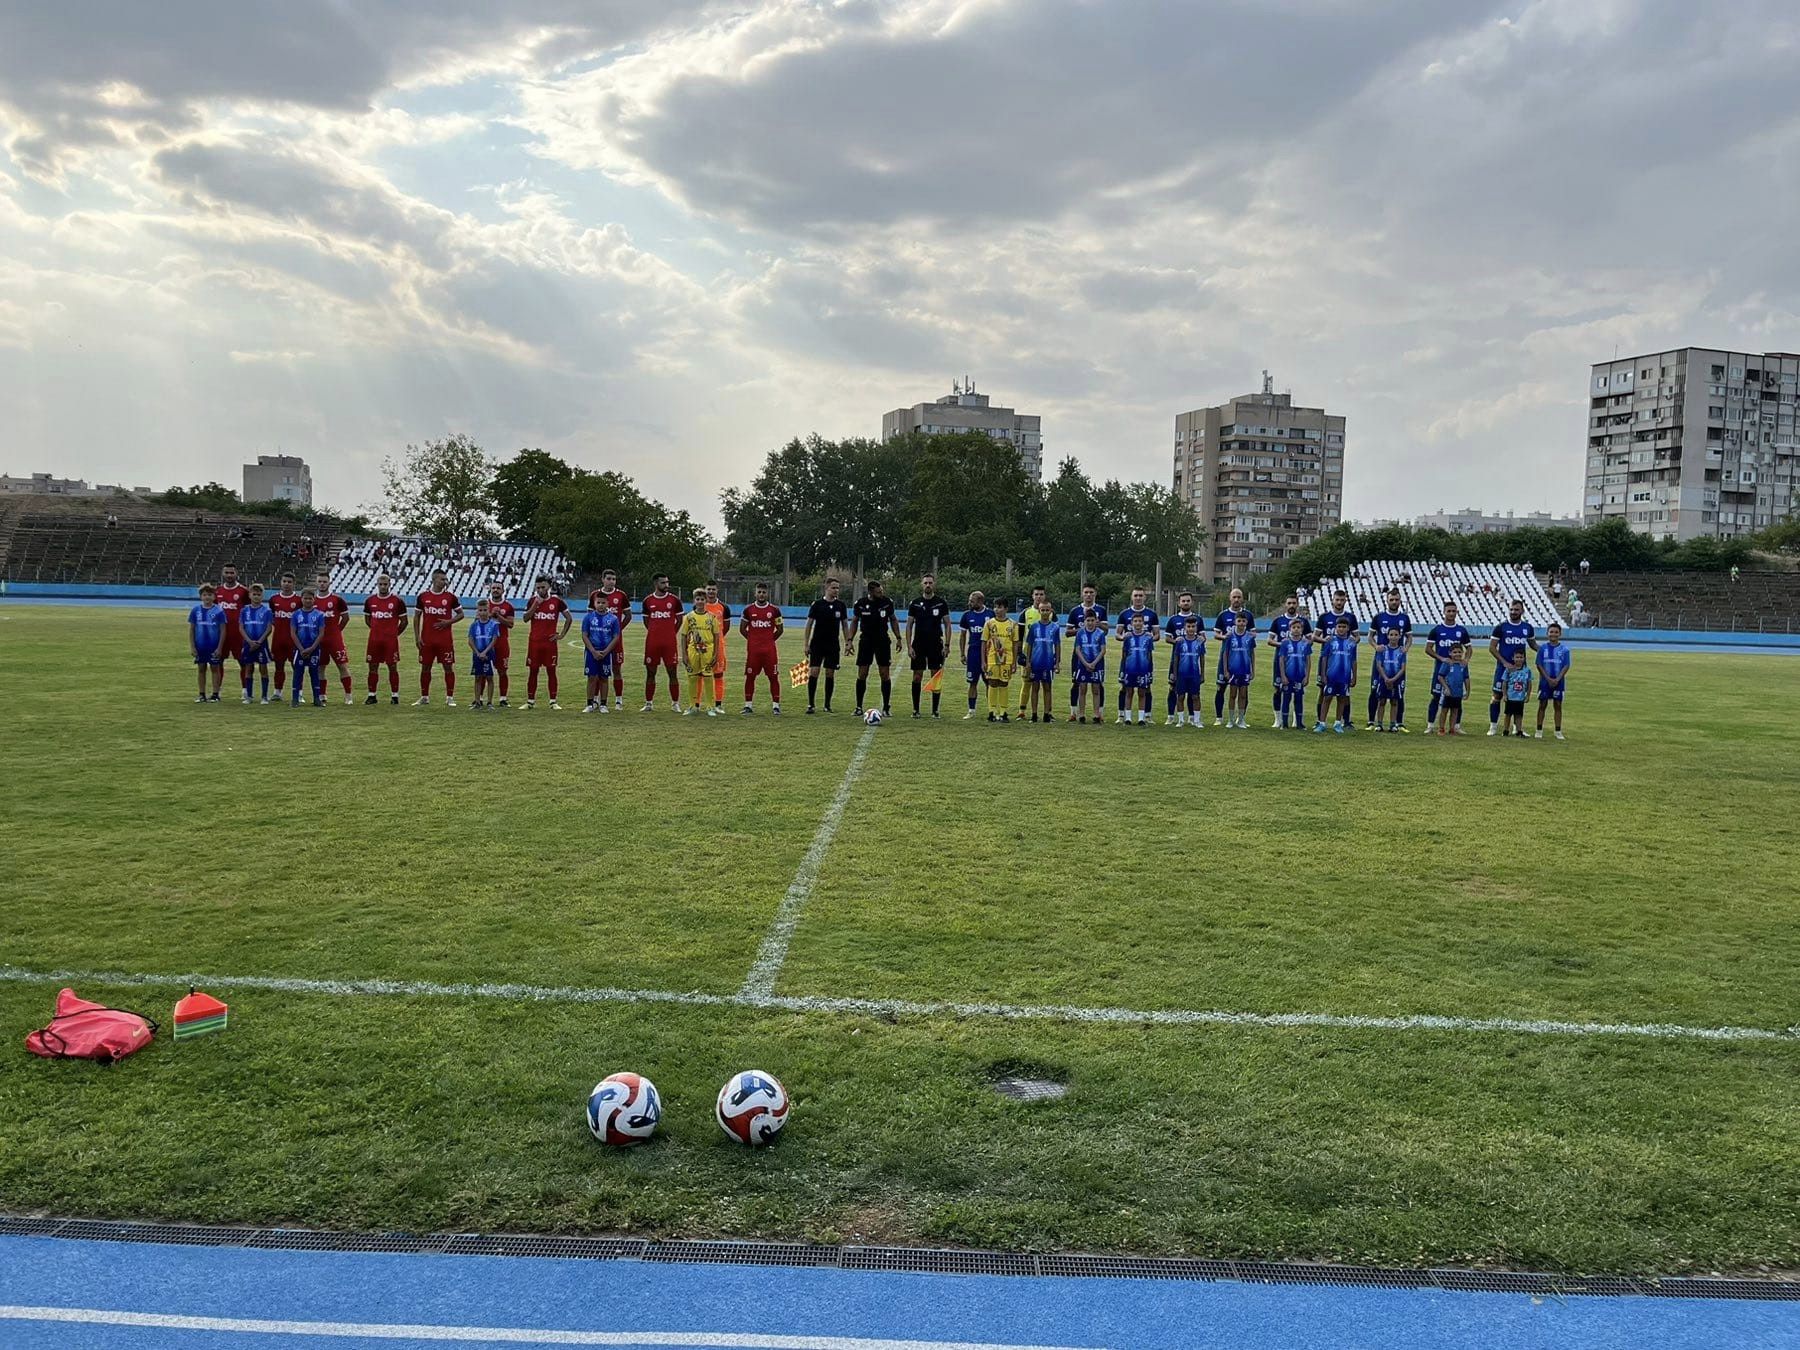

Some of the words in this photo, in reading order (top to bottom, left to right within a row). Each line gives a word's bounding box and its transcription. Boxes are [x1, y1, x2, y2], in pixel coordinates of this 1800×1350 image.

[424, 606, 447, 615] efbet
[650, 610, 671, 618] efbet
[371, 611, 392, 619] efbet
[534, 611, 555, 620] efbet
[751, 620, 771, 628] efbet
[1506, 637, 1526, 645] efbe
